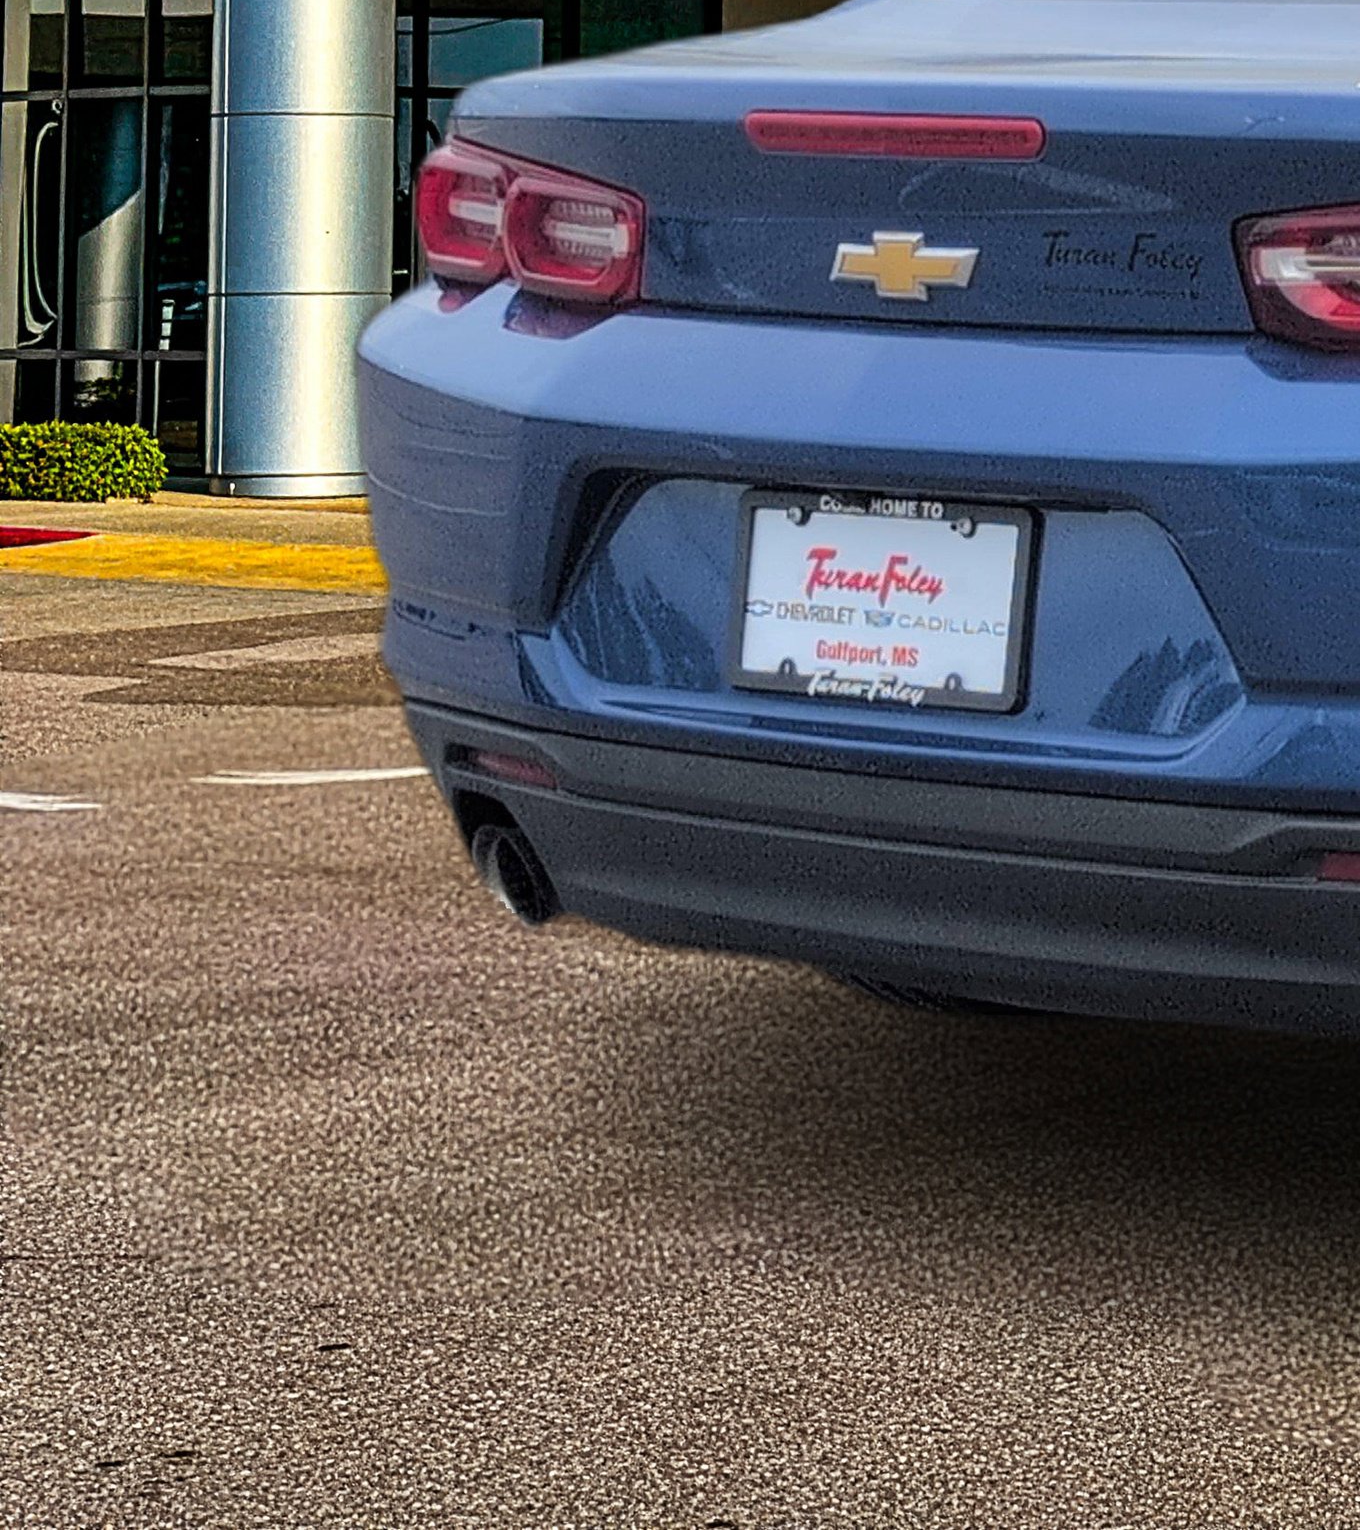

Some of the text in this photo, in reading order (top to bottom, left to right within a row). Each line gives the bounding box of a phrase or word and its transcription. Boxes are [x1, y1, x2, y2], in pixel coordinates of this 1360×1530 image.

[1042, 229, 1203, 282] Turan Foley
[869, 497, 918, 518] HOME
[920, 501, 944, 519] TO
[806, 547, 945, 608] Turan Foley
[776, 602, 1006, 638] CHEVROLET CADILLAC
[816, 639, 919, 668] Gulfport, MS
